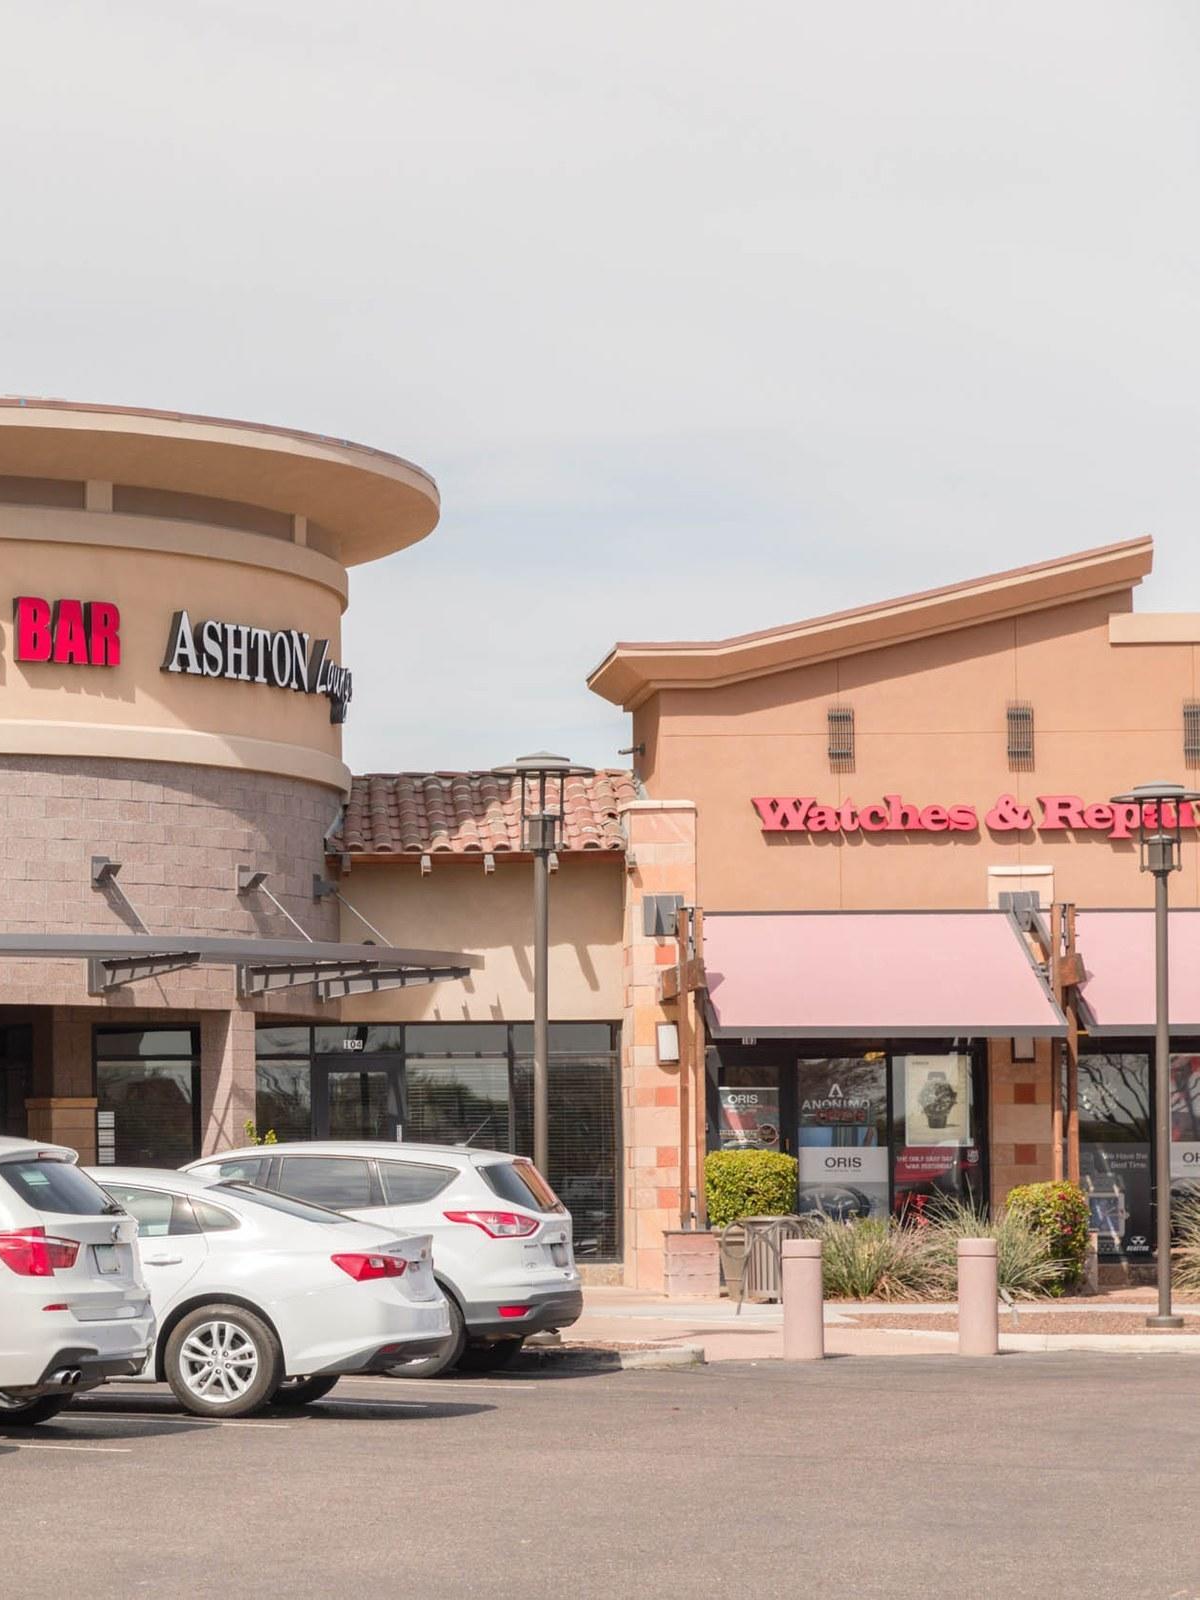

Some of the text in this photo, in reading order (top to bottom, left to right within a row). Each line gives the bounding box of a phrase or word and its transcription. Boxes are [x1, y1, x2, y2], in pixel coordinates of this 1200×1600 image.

[17, 597, 121, 666] BAR
[168, 609, 309, 693] ASHTON
[752, 794, 1200, 838] Watches & Repai
[727, 1094, 758, 1104] ORIS
[802, 1099, 871, 1111] ANONIMO
[825, 1157, 862, 1168] ORIS
